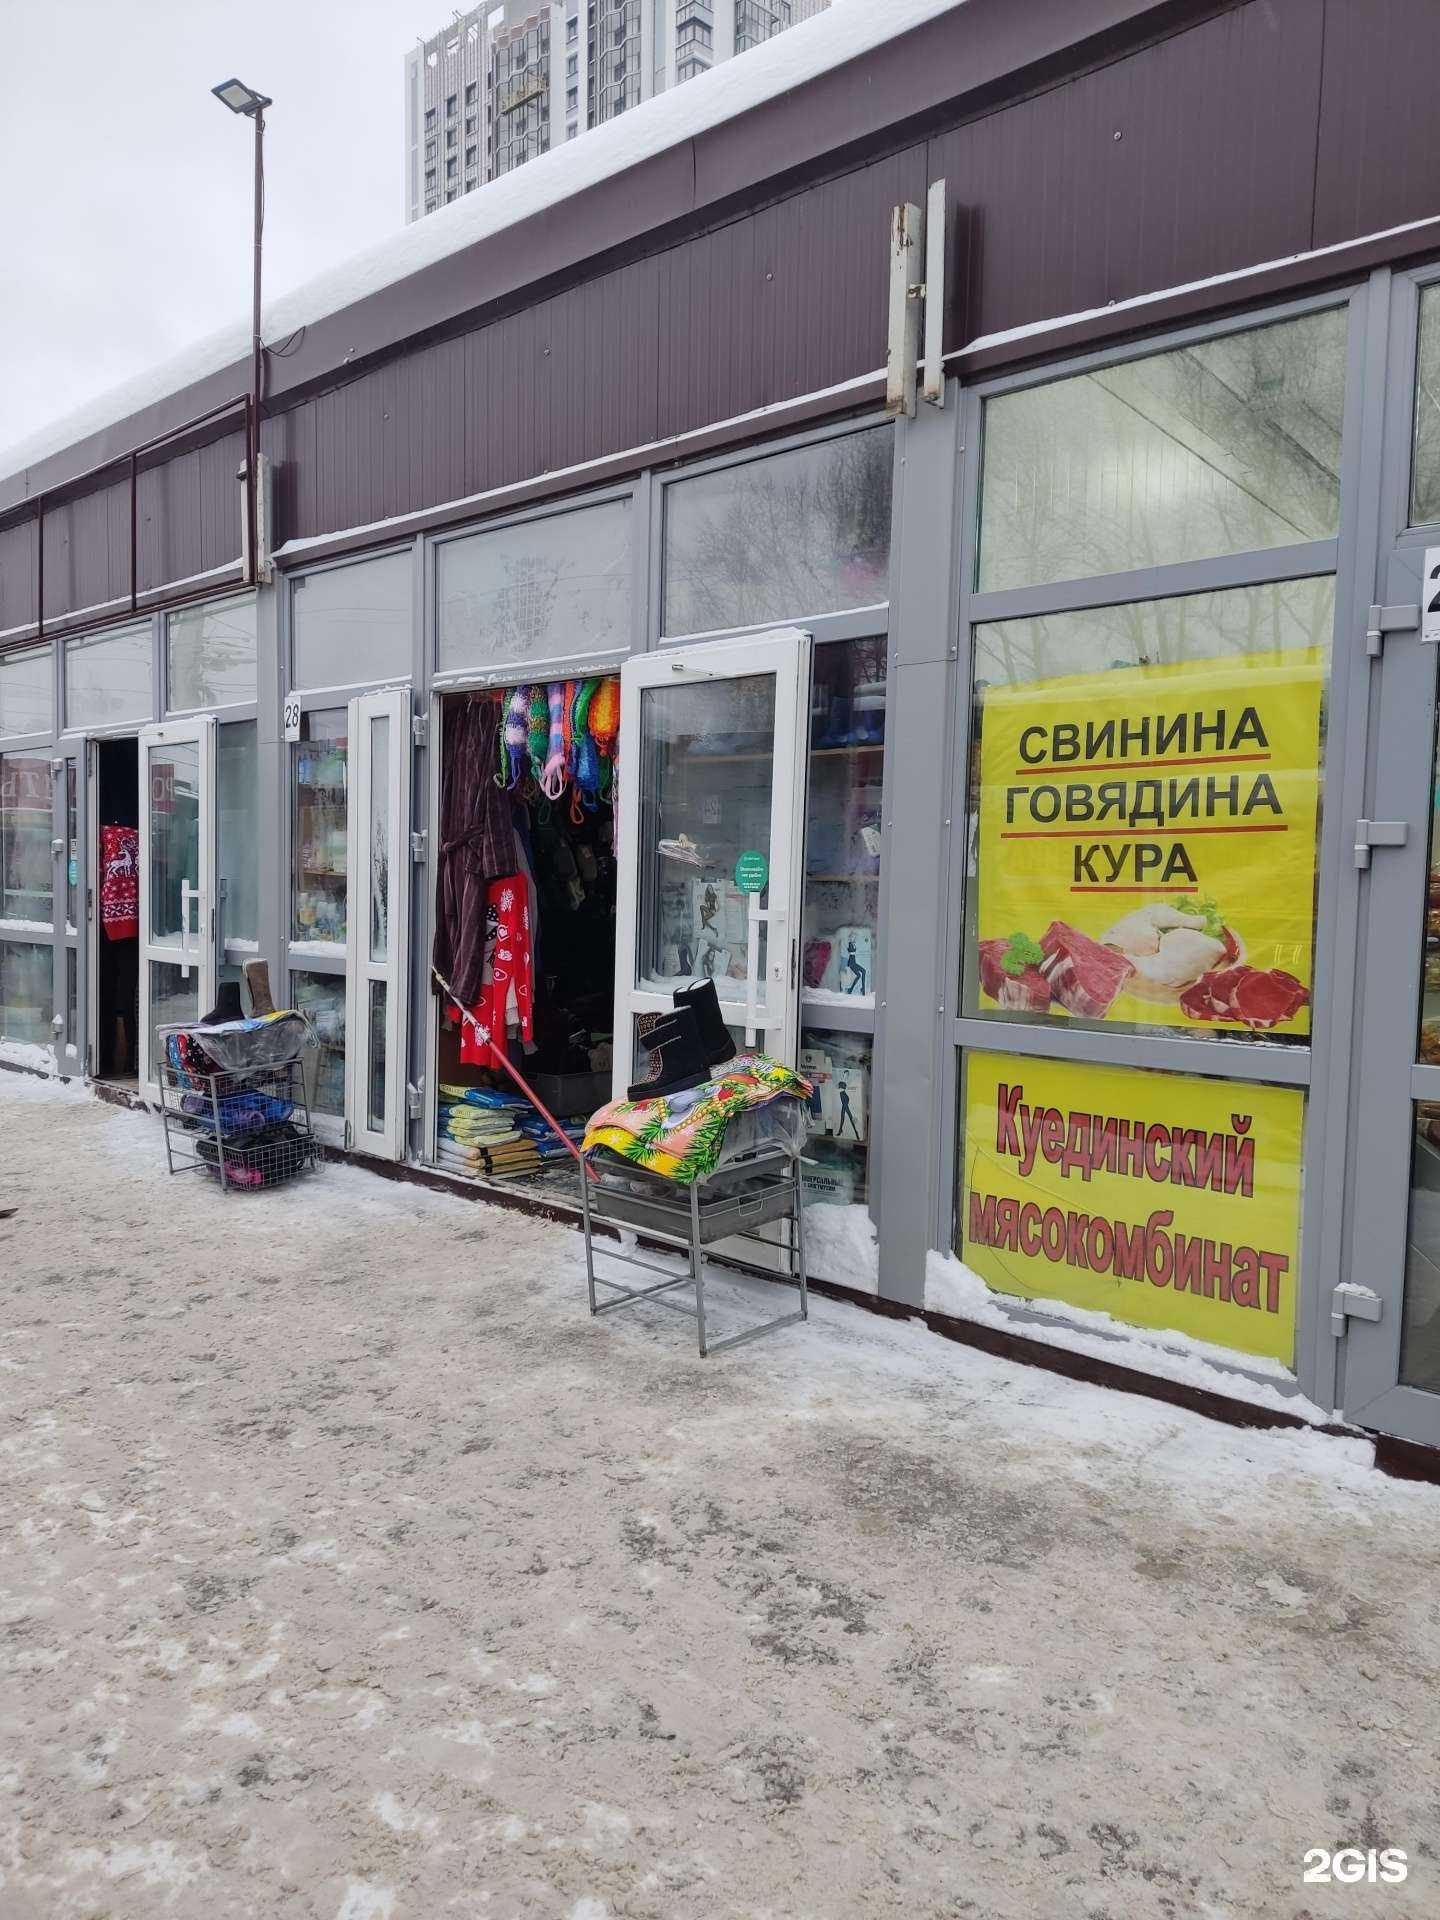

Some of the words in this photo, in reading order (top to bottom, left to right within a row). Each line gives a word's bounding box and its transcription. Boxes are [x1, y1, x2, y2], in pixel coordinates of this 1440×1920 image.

[285, 703, 299, 728] 28
[1019, 707, 1268, 763] СВИНИНА
[1006, 773, 1283, 827] ГОВЯДИНА
[1074, 843, 1197, 882] КУРА
[997, 1083, 1255, 1199] Куединский
[969, 1191, 1289, 1314] мясокомбинат
